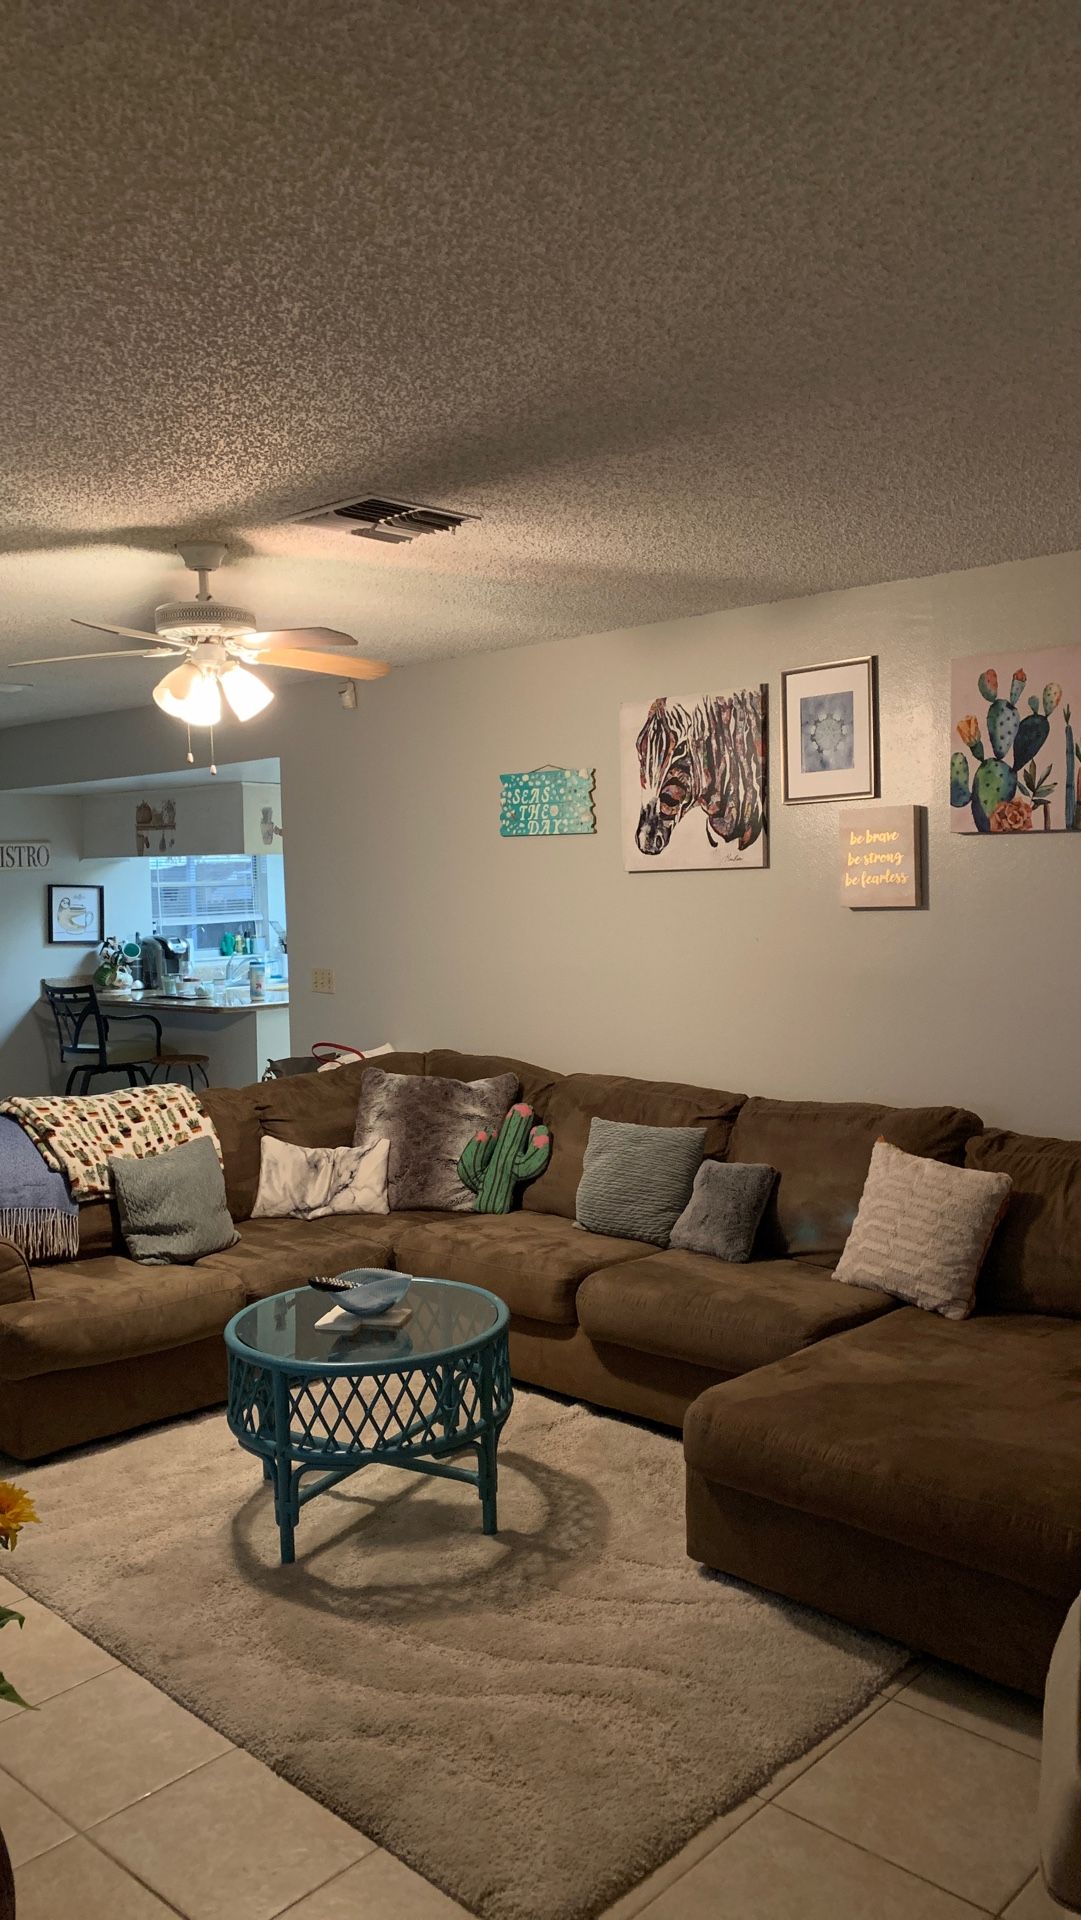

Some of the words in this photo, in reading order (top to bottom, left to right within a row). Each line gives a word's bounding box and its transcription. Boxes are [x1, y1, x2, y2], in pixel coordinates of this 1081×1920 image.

[512, 787, 550, 804] SEAS
[519, 803, 549, 821] THE
[527, 819, 562, 835] DAY
[849, 831, 864, 845] be
[866, 829, 900, 844] brave
[0, 846, 50, 868] ISTRO
[847, 852, 862, 866] be
[863, 851, 904, 866] strong
[845, 872, 859, 887] be
[861, 869, 908, 888] fearless
